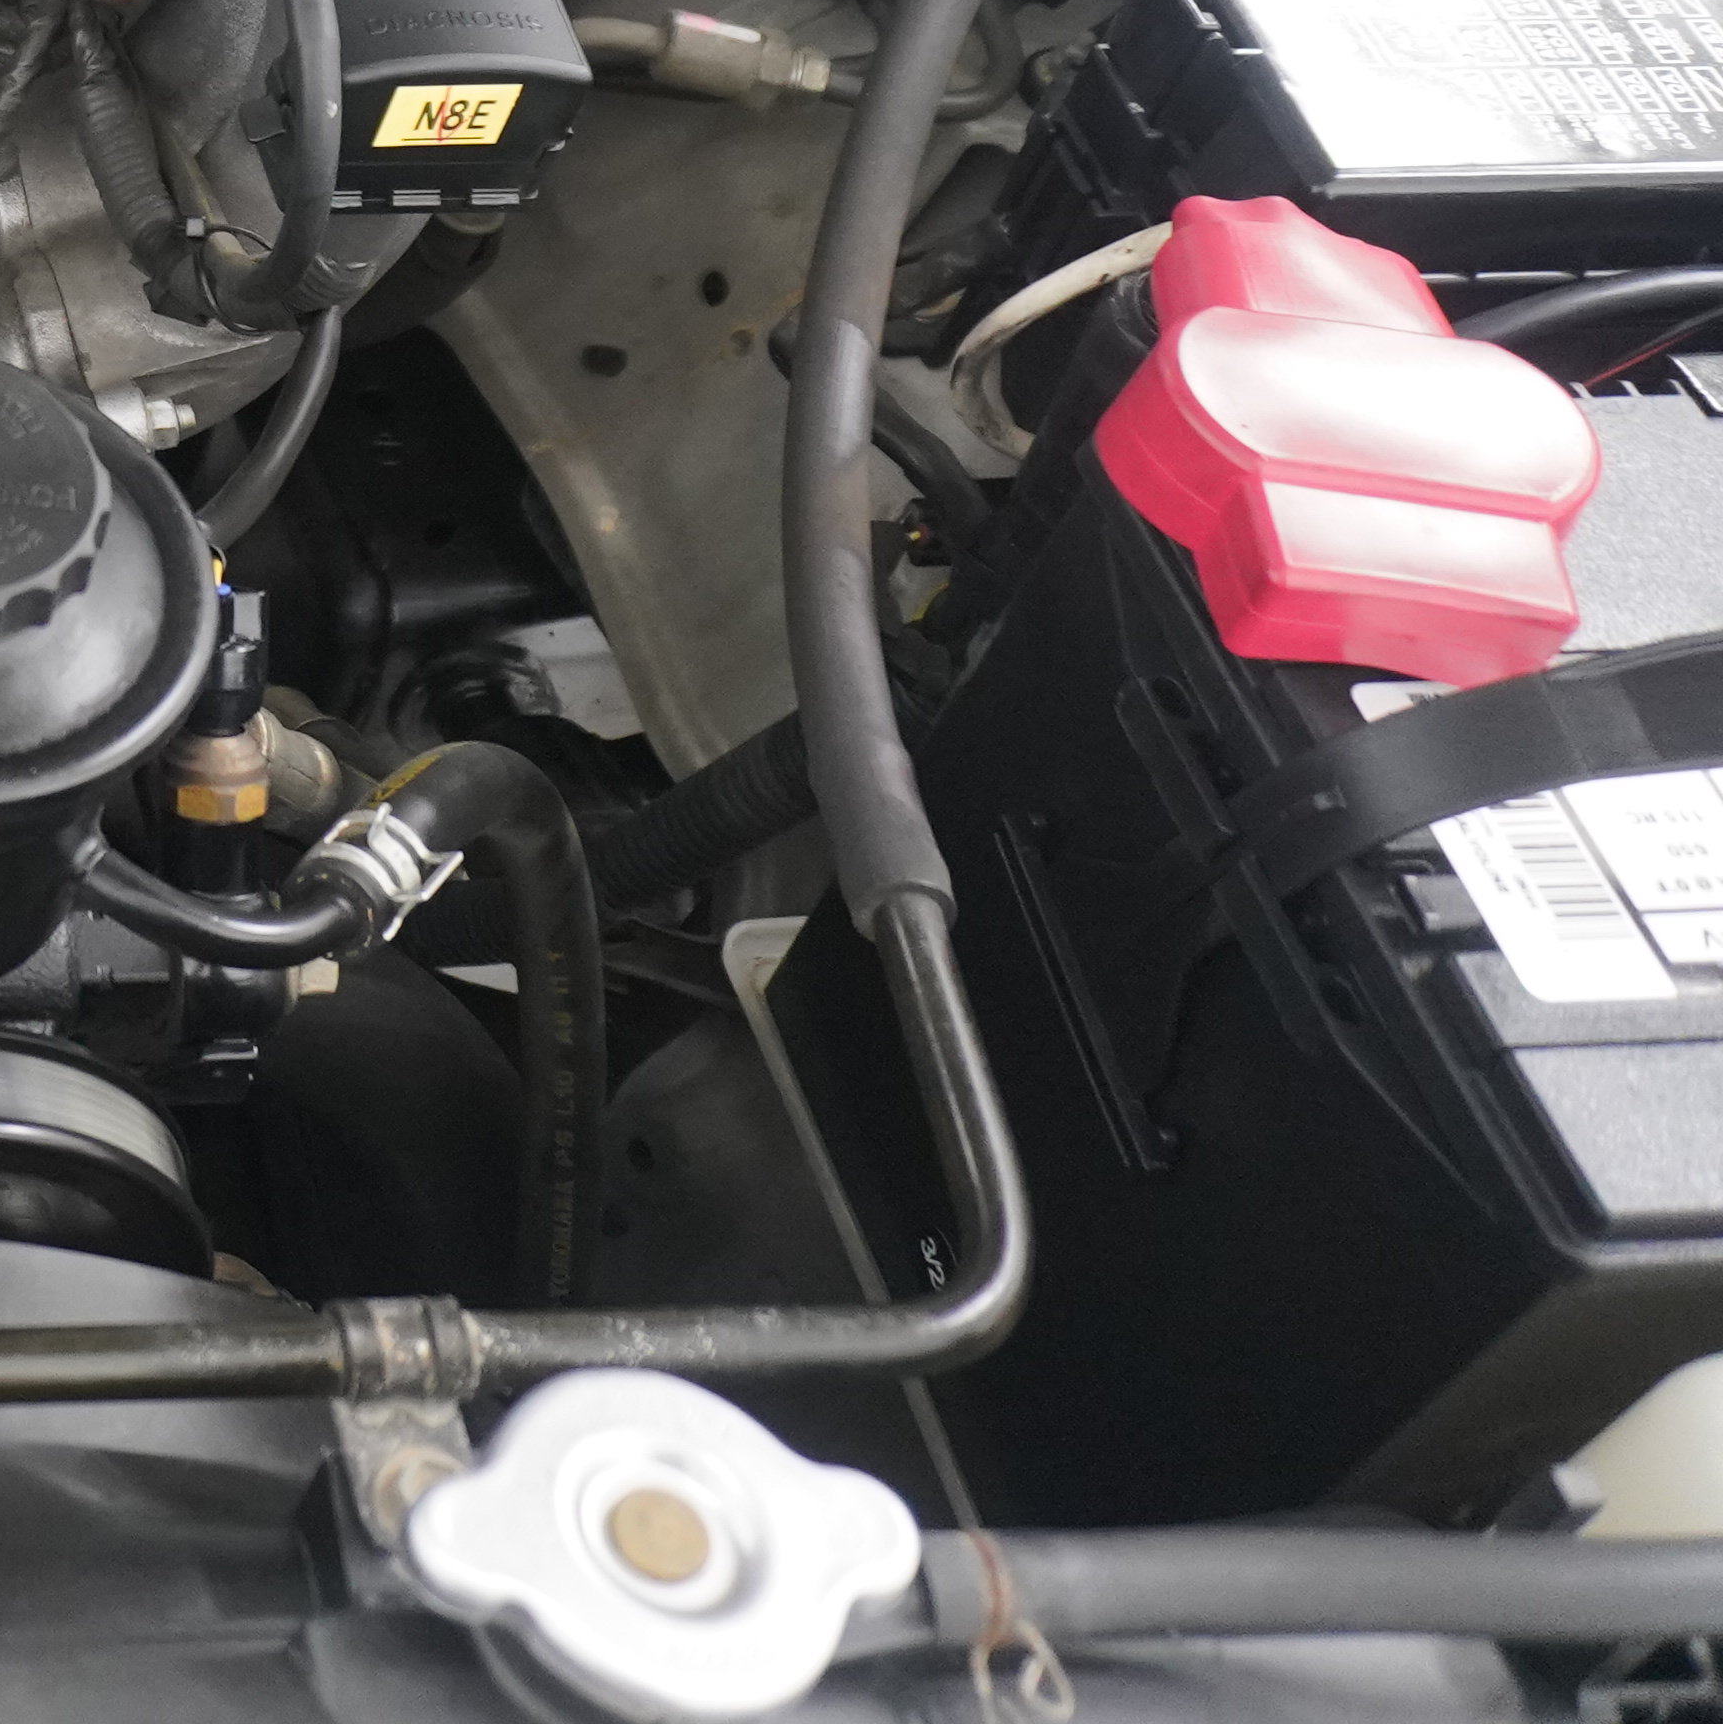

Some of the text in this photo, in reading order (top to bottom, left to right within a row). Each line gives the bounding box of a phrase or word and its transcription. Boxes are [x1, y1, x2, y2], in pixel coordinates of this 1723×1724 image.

[363, 9, 545, 36] DIAGNOSIS
[1618, 74, 1652, 104] 10A
[1658, 74, 1692, 105] 10A
[414, 99, 498, 131] N8E
